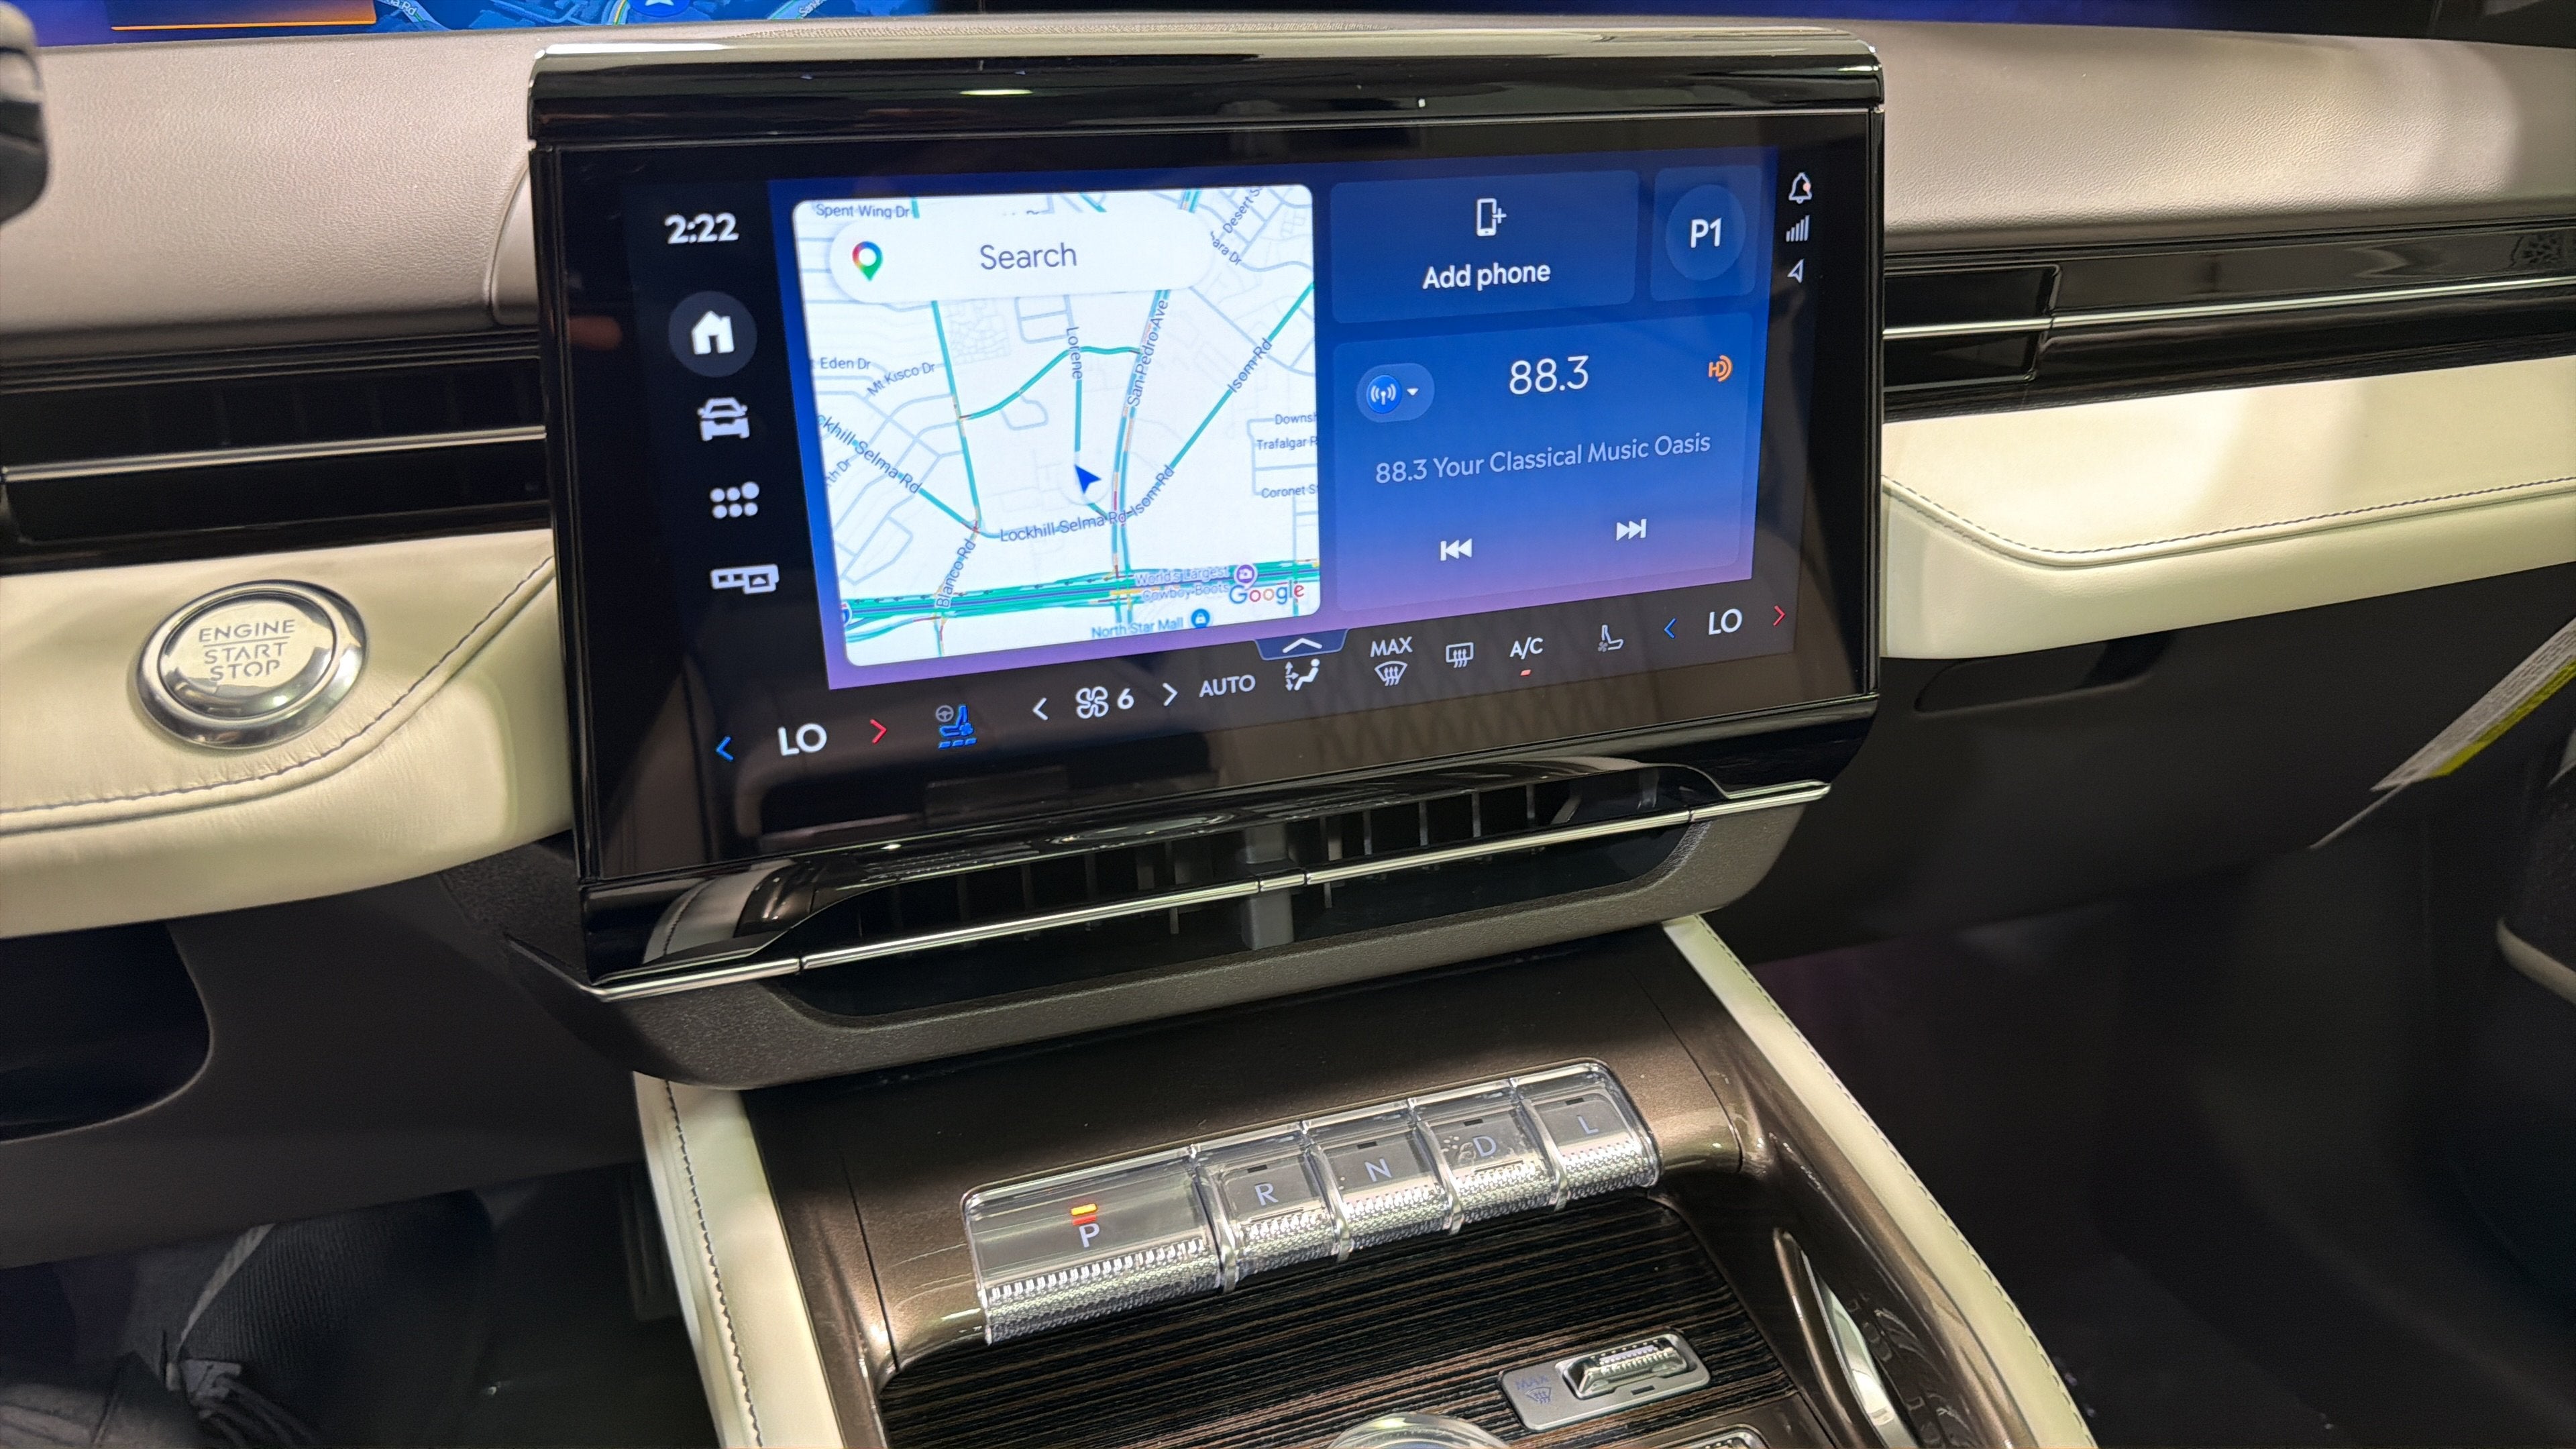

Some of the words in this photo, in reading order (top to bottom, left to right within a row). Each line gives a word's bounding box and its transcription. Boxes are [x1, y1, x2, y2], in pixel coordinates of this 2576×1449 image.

[402, 1, 417, 16] Rd
[816, 203, 853, 217] Spent
[857, 205, 892, 220] Wing
[896, 205, 910, 217] Dr
[1222, 196, 1254, 233] Desert
[665, 213, 739, 244] 2:22
[1690, 218, 1722, 249] P1
[980, 242, 1077, 270] Search
[1229, 251, 1242, 266] Dr
[1422, 266, 1471, 289] Add
[1477, 262, 1551, 291] phone
[1150, 300, 1169, 329] Ave
[820, 357, 855, 369] Eden
[857, 358, 871, 370] Dr
[1066, 326, 1083, 380] Lorene
[1135, 331, 1159, 375] Pedro
[1227, 360, 1258, 393] Isom
[1252, 337, 1273, 359] Rd
[867, 380, 884, 396] Mt
[883, 367, 920, 385] Kisco
[921, 362, 935, 375] Dr
[1509, 355, 1589, 394] 88.3
[1127, 380, 1145, 407] San
[1256, 437, 1307, 451] Trafalgar
[837, 459, 851, 472] Dr
[855, 441, 899, 479] Selma
[899, 473, 922, 494] Rd
[1375, 459, 1428, 484] 88.3
[1433, 455, 1485, 478] Your
[1489, 444, 1582, 472] Classical
[1587, 438, 1649, 464] Music
[1654, 432, 1711, 457] Oasis
[1130, 486, 1161, 516] Isom
[1155, 464, 1175, 486] Rd
[1260, 486, 1305, 498] Coronet
[1000, 522, 1056, 542] Lockhill
[1059, 516, 1106, 534] Selma
[1108, 510, 1126, 524] Rd
[936, 561, 964, 608] Blanco
[957, 538, 976, 559] Rd
[1229, 578, 1305, 604] Google
[199, 619, 294, 642] ENGINE
[1091, 623, 1127, 638] North
[1130, 621, 1155, 634] Star
[1158, 616, 1183, 631] Mall
[1709, 608, 1743, 636] LO
[204, 641, 288, 665] START
[1370, 636, 1413, 658] MAX
[1509, 637, 1544, 659] A/C
[209, 660, 280, 682] STOP
[1116, 688, 1135, 710] 6
[1199, 674, 1256, 698] AUTO
[777, 722, 828, 757] LO
[1576, 1114, 1599, 1136] L
[1474, 1134, 1498, 1159] D
[1364, 1157, 1392, 1185] N
[1254, 1182, 1279, 1208] R
[1078, 1222, 1101, 1249] P
